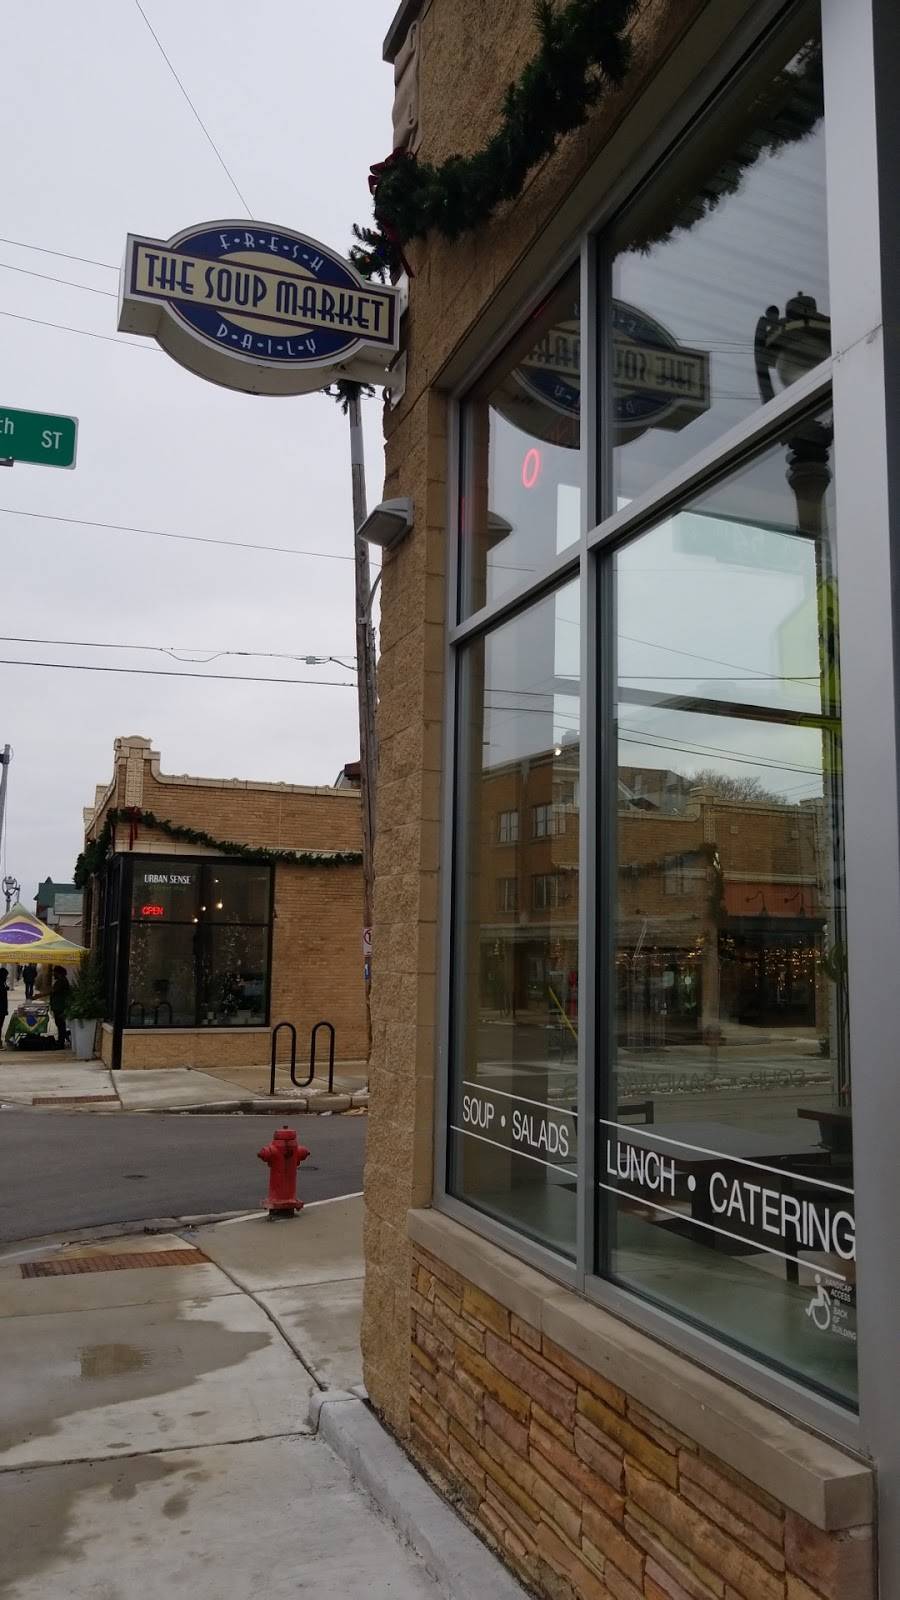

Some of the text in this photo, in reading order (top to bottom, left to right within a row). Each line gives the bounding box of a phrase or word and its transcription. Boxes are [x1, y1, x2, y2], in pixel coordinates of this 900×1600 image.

[145, 253, 384, 332] THE SOUP MARKET
[41, 430, 63, 449] ST
[144, 874, 191, 884] URBAN SENSE
[142, 905, 164, 916] OPEN
[462, 1095, 569, 1157] SOUP SALADS
[606, 1139, 856, 1262] LUNCH CATERING
[831, 1288, 851, 1302] ACCESS
